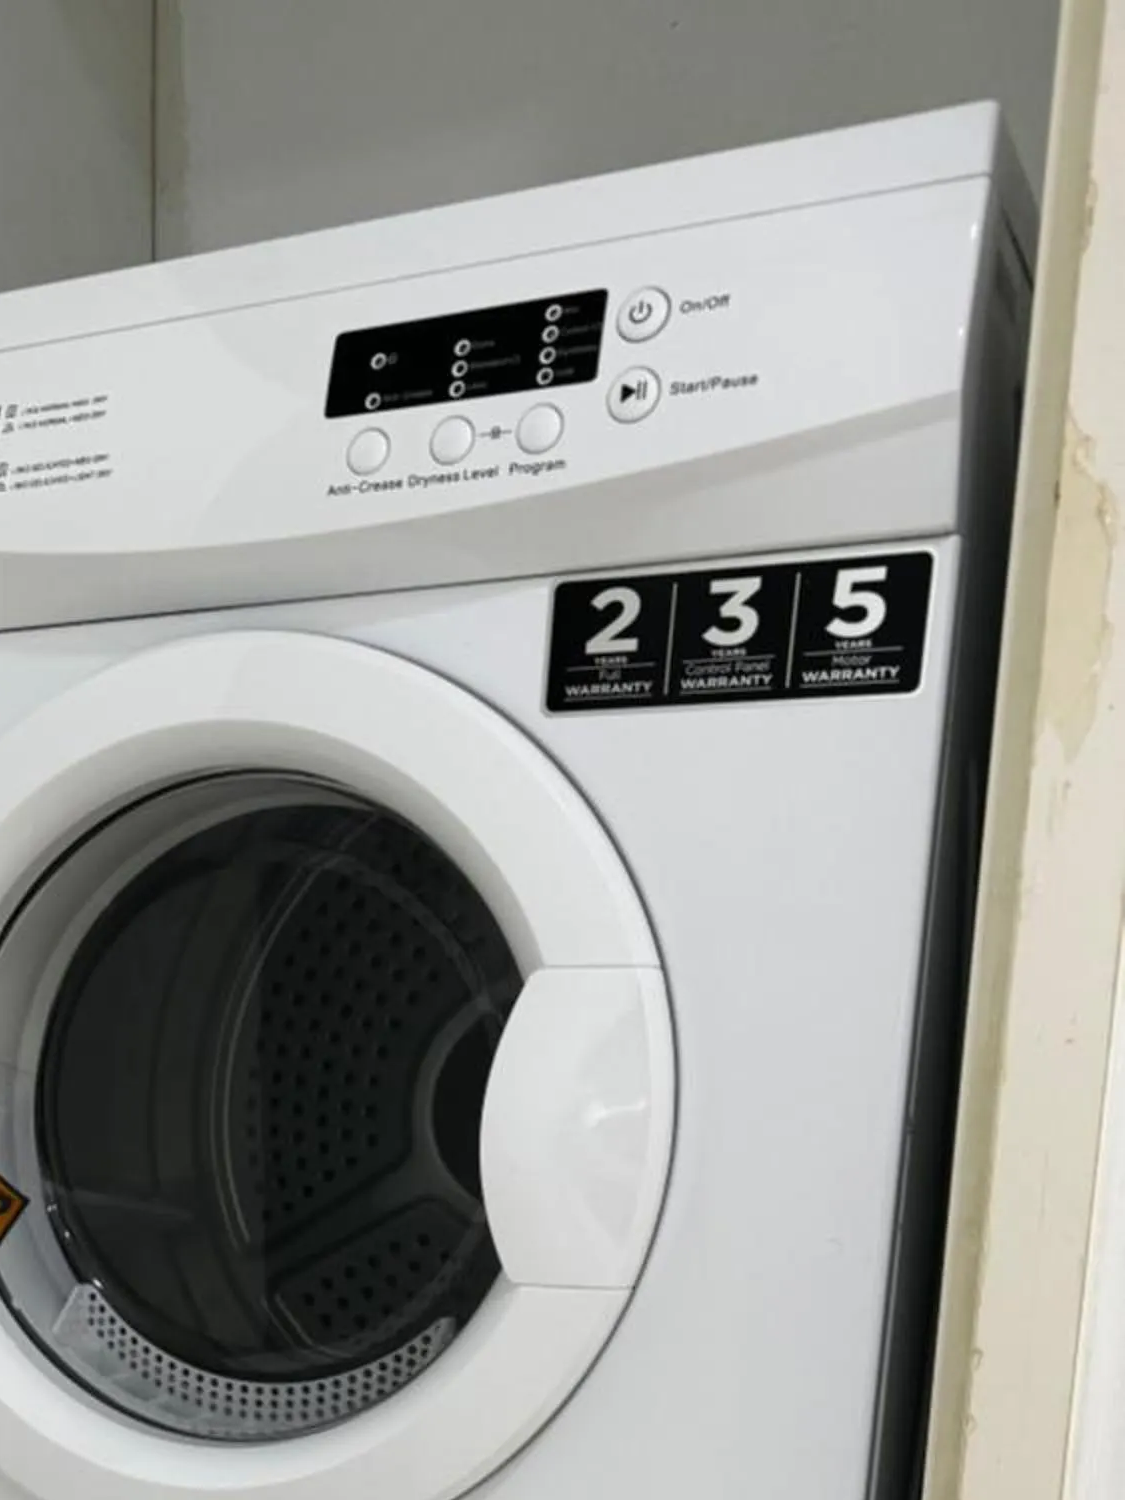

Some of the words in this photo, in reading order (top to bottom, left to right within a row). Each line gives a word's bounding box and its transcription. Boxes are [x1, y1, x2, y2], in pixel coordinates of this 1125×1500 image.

[679, 294, 731, 315] On/Off
[669, 373, 759, 397] Start/Pause
[508, 457, 566, 477] Program
[327, 475, 403, 498] Anti-Crease
[408, 470, 460, 491] Dryness
[462, 465, 499, 484] Level
[700, 575, 763, 647] 3
[824, 565, 888, 639] 5
[584, 586, 642, 655] 2
[835, 638, 873, 650] YEARS
[684, 661, 732, 676] Control
[735, 659, 772, 674] Panel
[832, 653, 872, 667] Motor
[680, 673, 774, 690] WARRANTY
[801, 666, 901, 683] WARRANTY
[564, 680, 653, 697] WARRANTY
